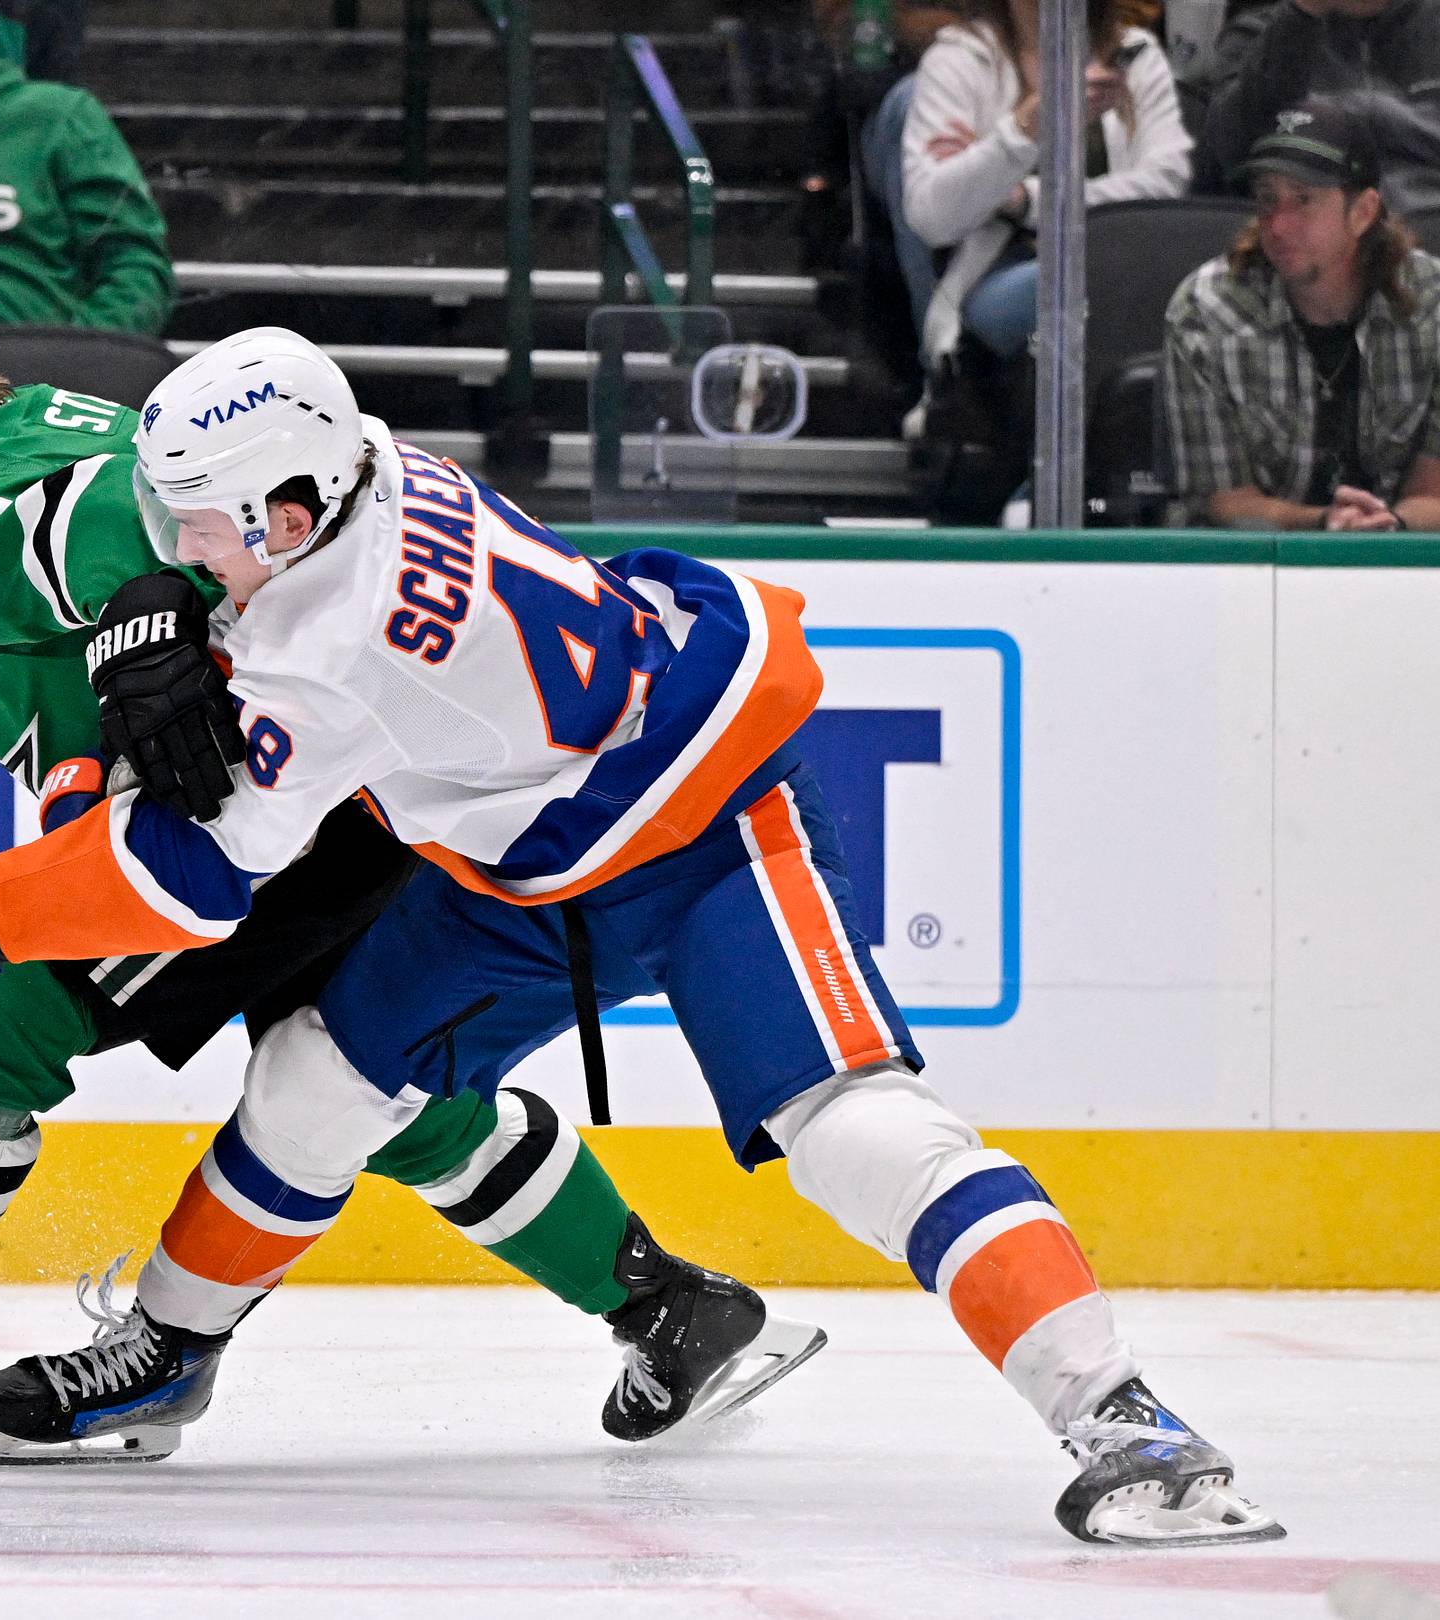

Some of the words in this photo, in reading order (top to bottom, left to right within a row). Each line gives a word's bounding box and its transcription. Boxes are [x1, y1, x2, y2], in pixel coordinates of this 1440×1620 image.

[189, 381, 277, 431] VIAM
[240, 708, 294, 789] 8
[814, 948, 856, 1024] WARRIOR
[646, 1305, 669, 1340] TRUE
